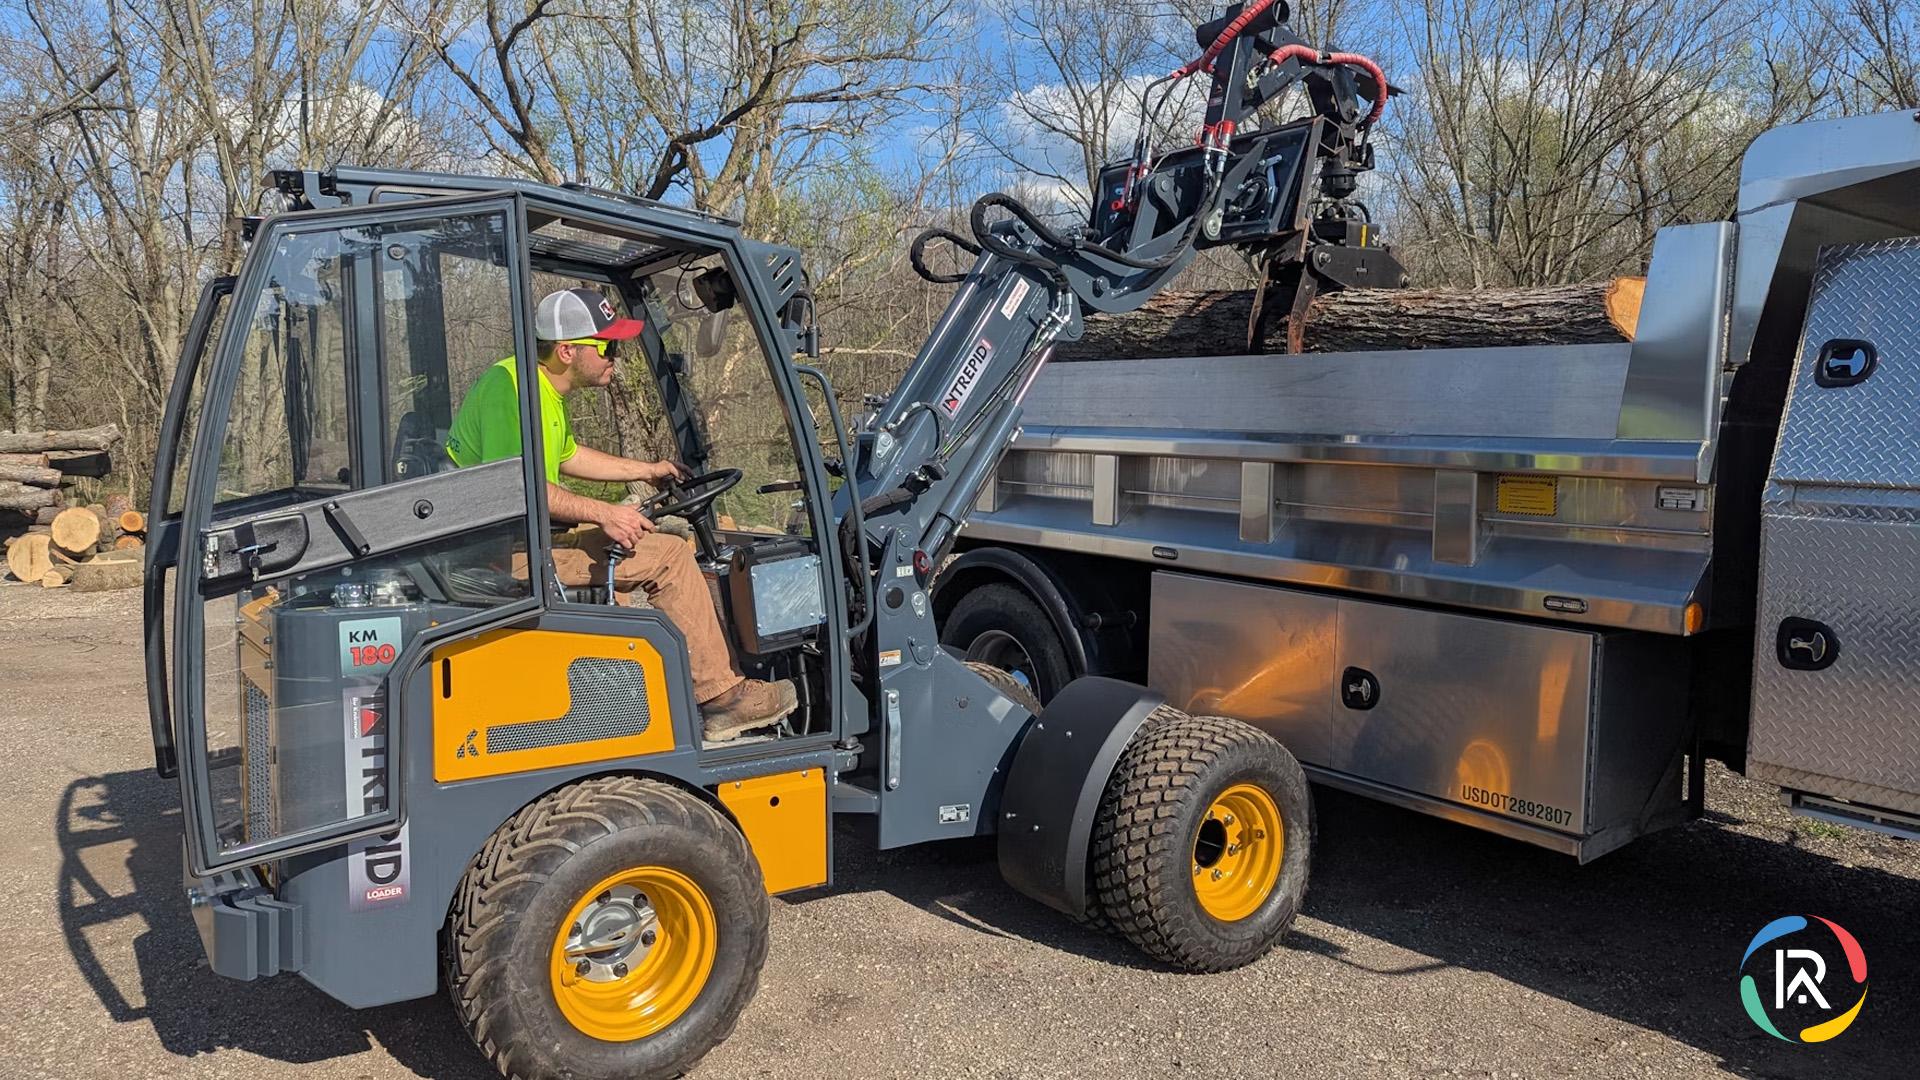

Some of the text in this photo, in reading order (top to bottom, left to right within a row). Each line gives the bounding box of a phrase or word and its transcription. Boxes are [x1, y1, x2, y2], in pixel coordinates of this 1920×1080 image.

[942, 345, 987, 414] INTREPID
[349, 629, 378, 643] KM
[350, 643, 396, 667] 180
[1462, 784, 1573, 826] USDOT2892807
[366, 886, 402, 900] LOADER
